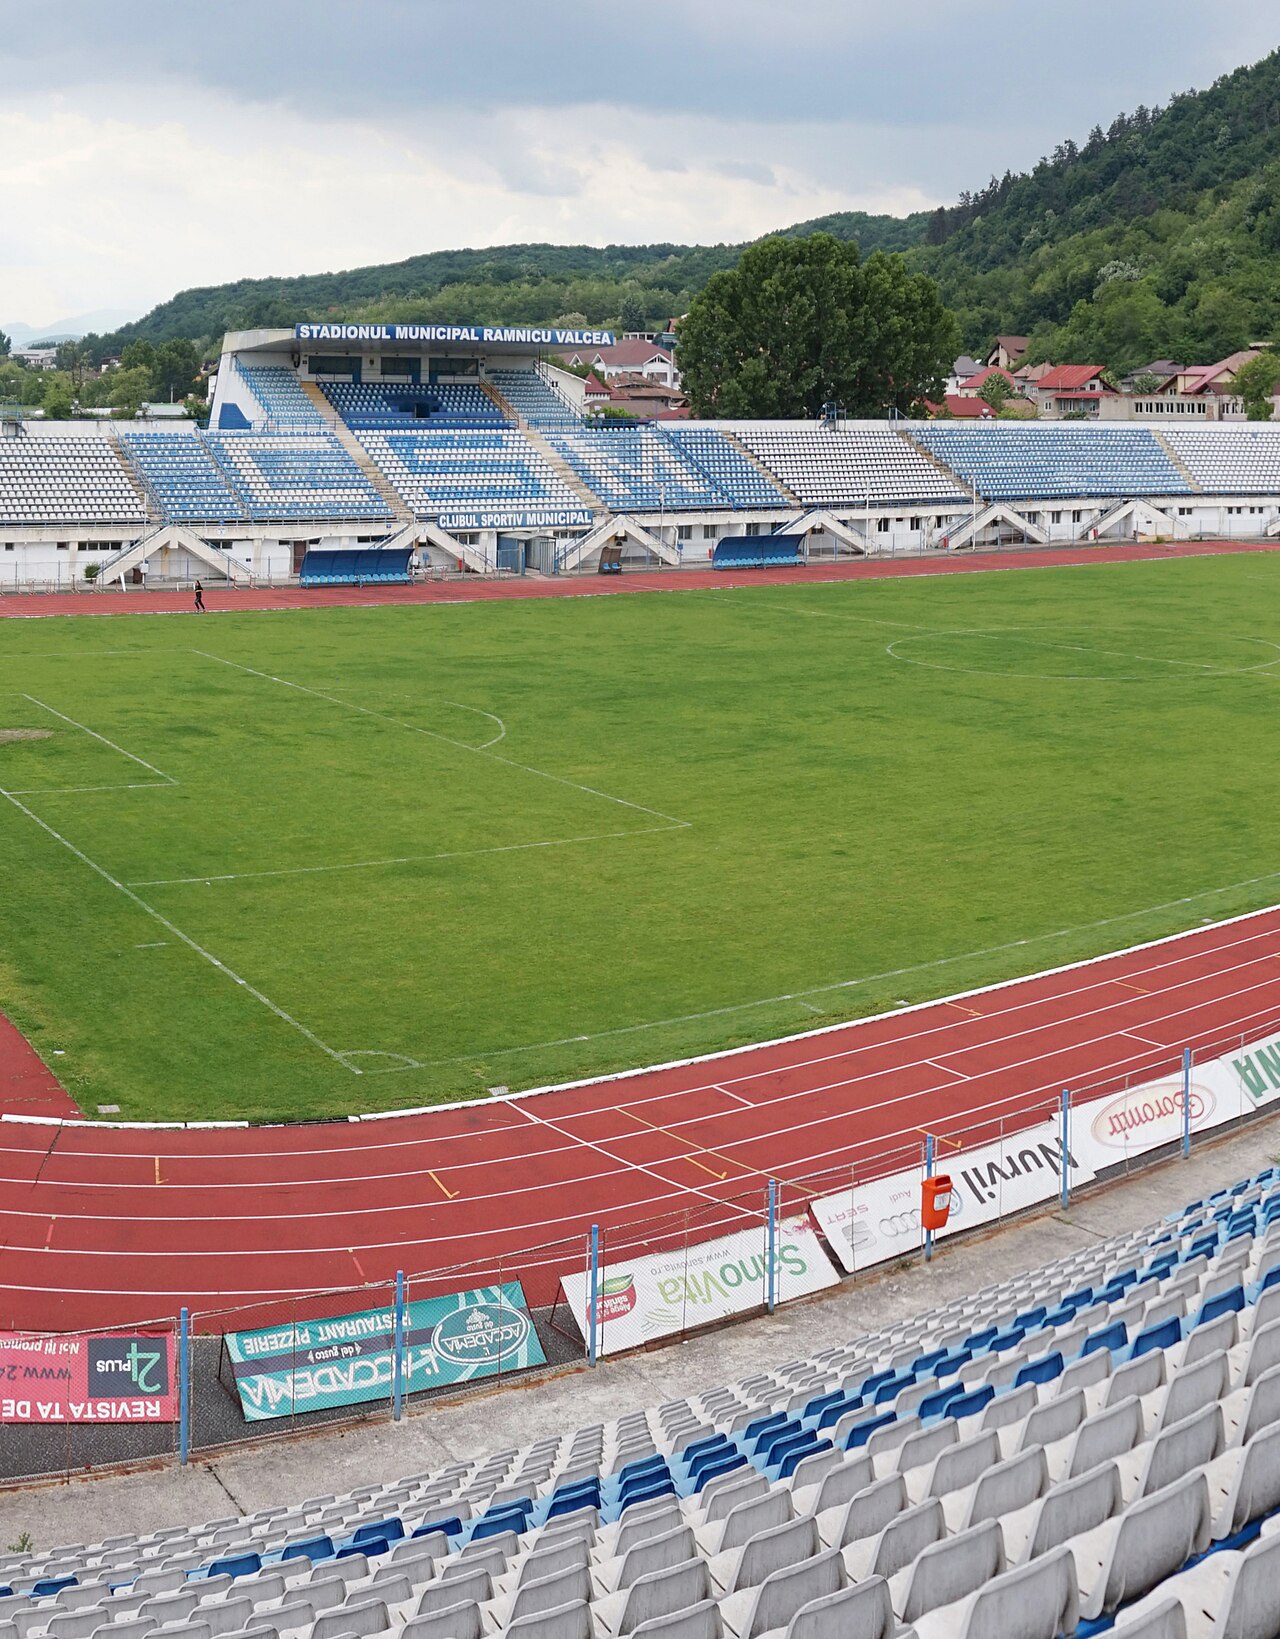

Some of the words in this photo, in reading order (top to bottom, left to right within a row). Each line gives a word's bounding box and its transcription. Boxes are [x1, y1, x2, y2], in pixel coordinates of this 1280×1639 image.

[299, 325, 391, 340] STADIONUL
[395, 326, 480, 341] MUNICIPAL
[483, 328, 552, 343] RAMNICU
[556, 331, 612, 345] VALCEA
[438, 514, 479, 527] CLUBUL
[481, 513, 523, 526] SPORTIV
[526, 511, 592, 525] MUNICIPAL
[1108, 1091, 1206, 1141] Boromir
[961, 1137, 1080, 1205] Nurvil
[889, 1189, 912, 1205] Audi
[826, 1204, 869, 1226] SEAT
[650, 1250, 731, 1275] www.sanovita.ro
[96, 1359, 131, 1372] PLUS
[2, 1400, 31, 1418] DE
[36, 1401, 64, 1419] TA
[69, 1400, 161, 1418] REVISTA
